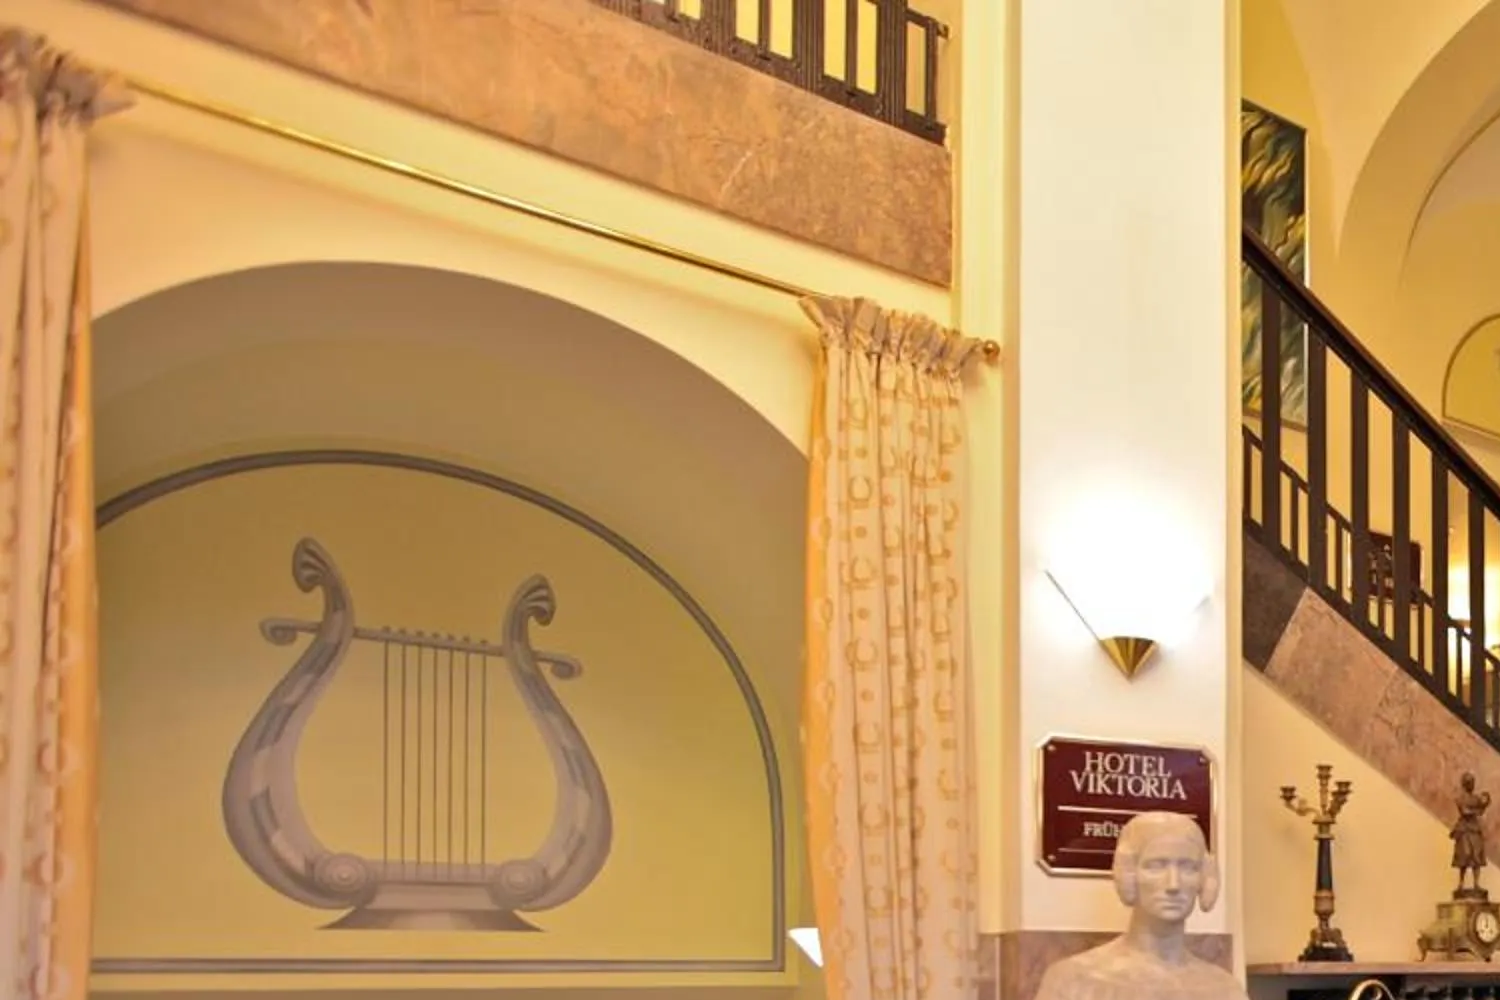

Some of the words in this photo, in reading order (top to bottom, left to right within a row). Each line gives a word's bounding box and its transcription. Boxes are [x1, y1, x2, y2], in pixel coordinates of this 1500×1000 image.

[1085, 751, 1172, 778] HOTEL
[1069, 769, 1187, 800] VIKTORIA
[1083, 820, 1121, 838] FRÜH
